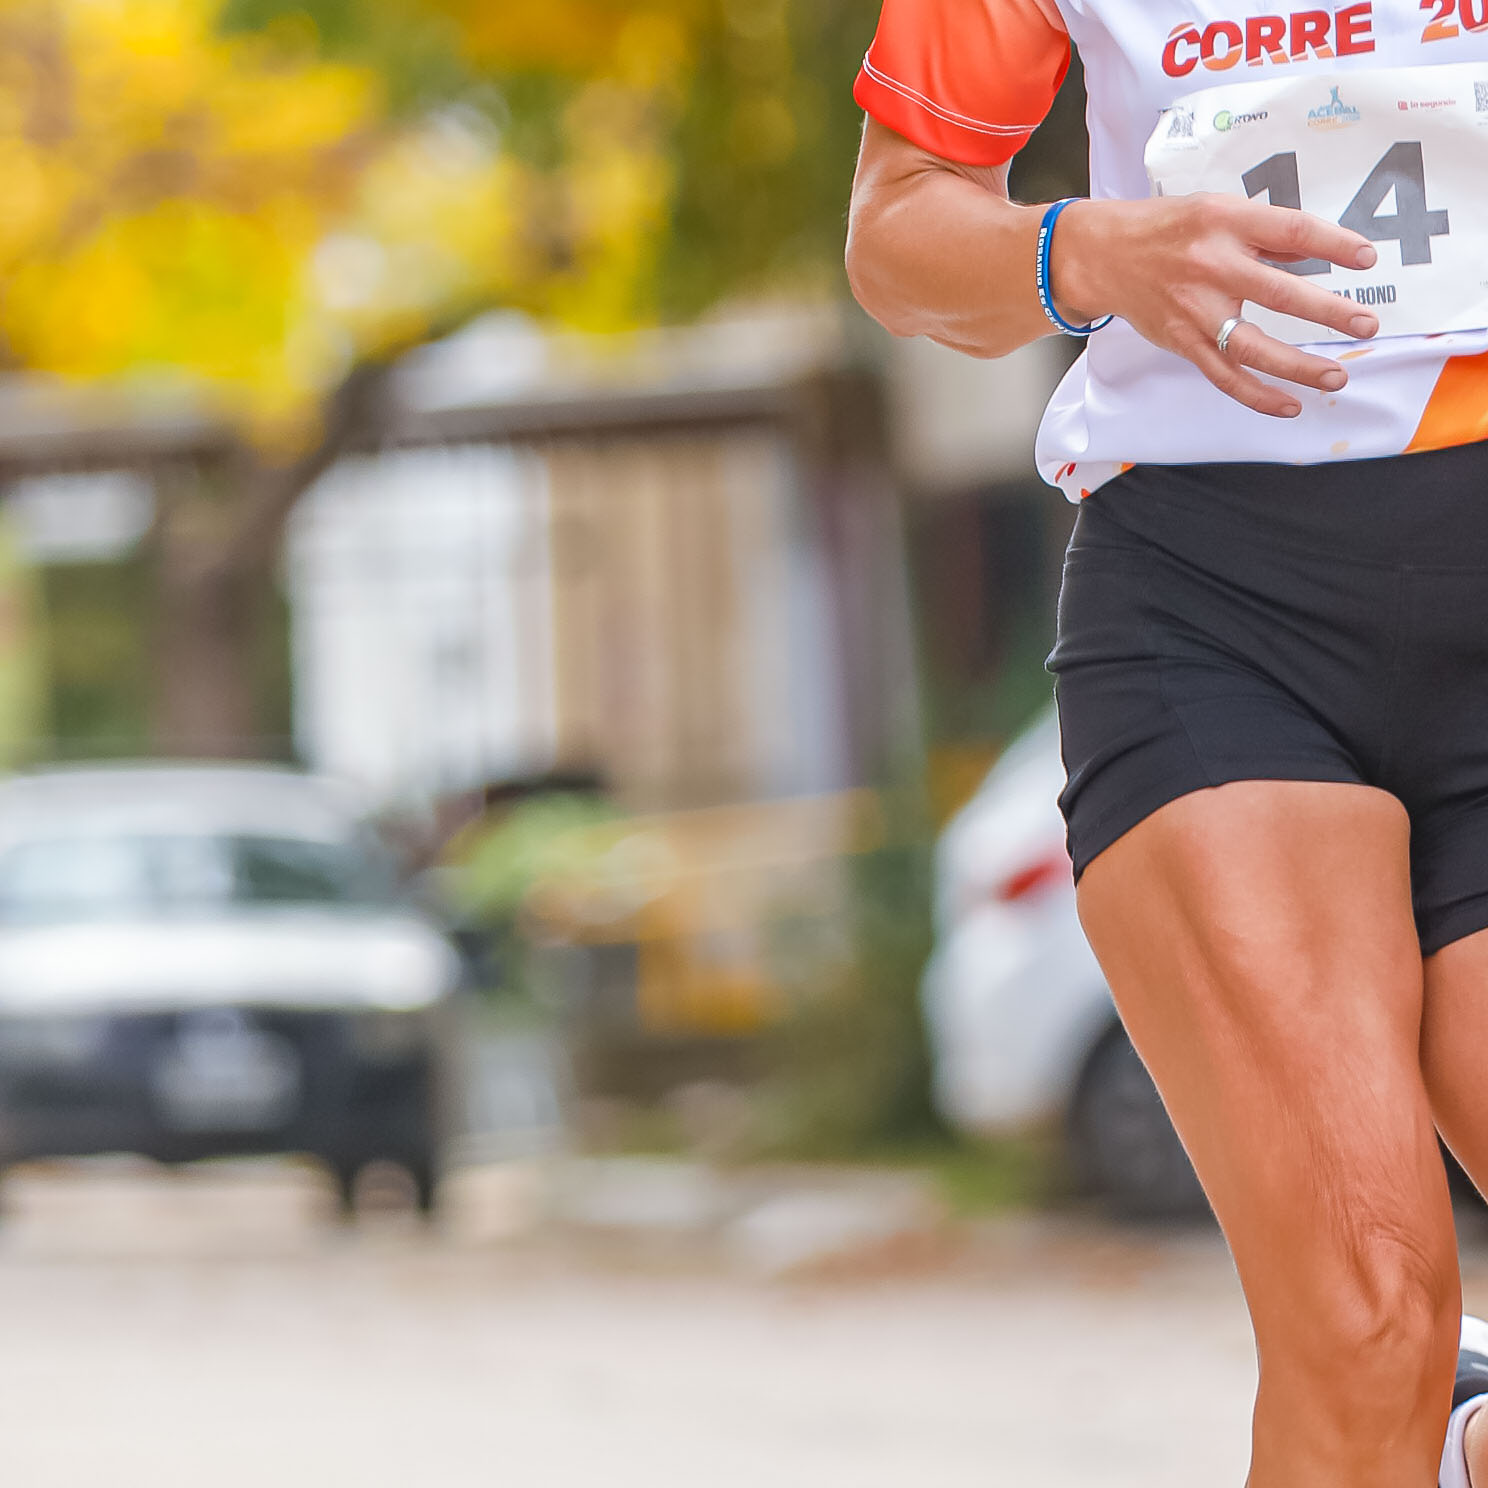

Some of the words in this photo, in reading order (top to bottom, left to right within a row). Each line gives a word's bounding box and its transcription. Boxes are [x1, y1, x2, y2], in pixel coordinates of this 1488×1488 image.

[1161, 1, 1375, 78] CORRE
[1241, 141, 1450, 277] 14
[1356, 284, 1397, 305] BOND
